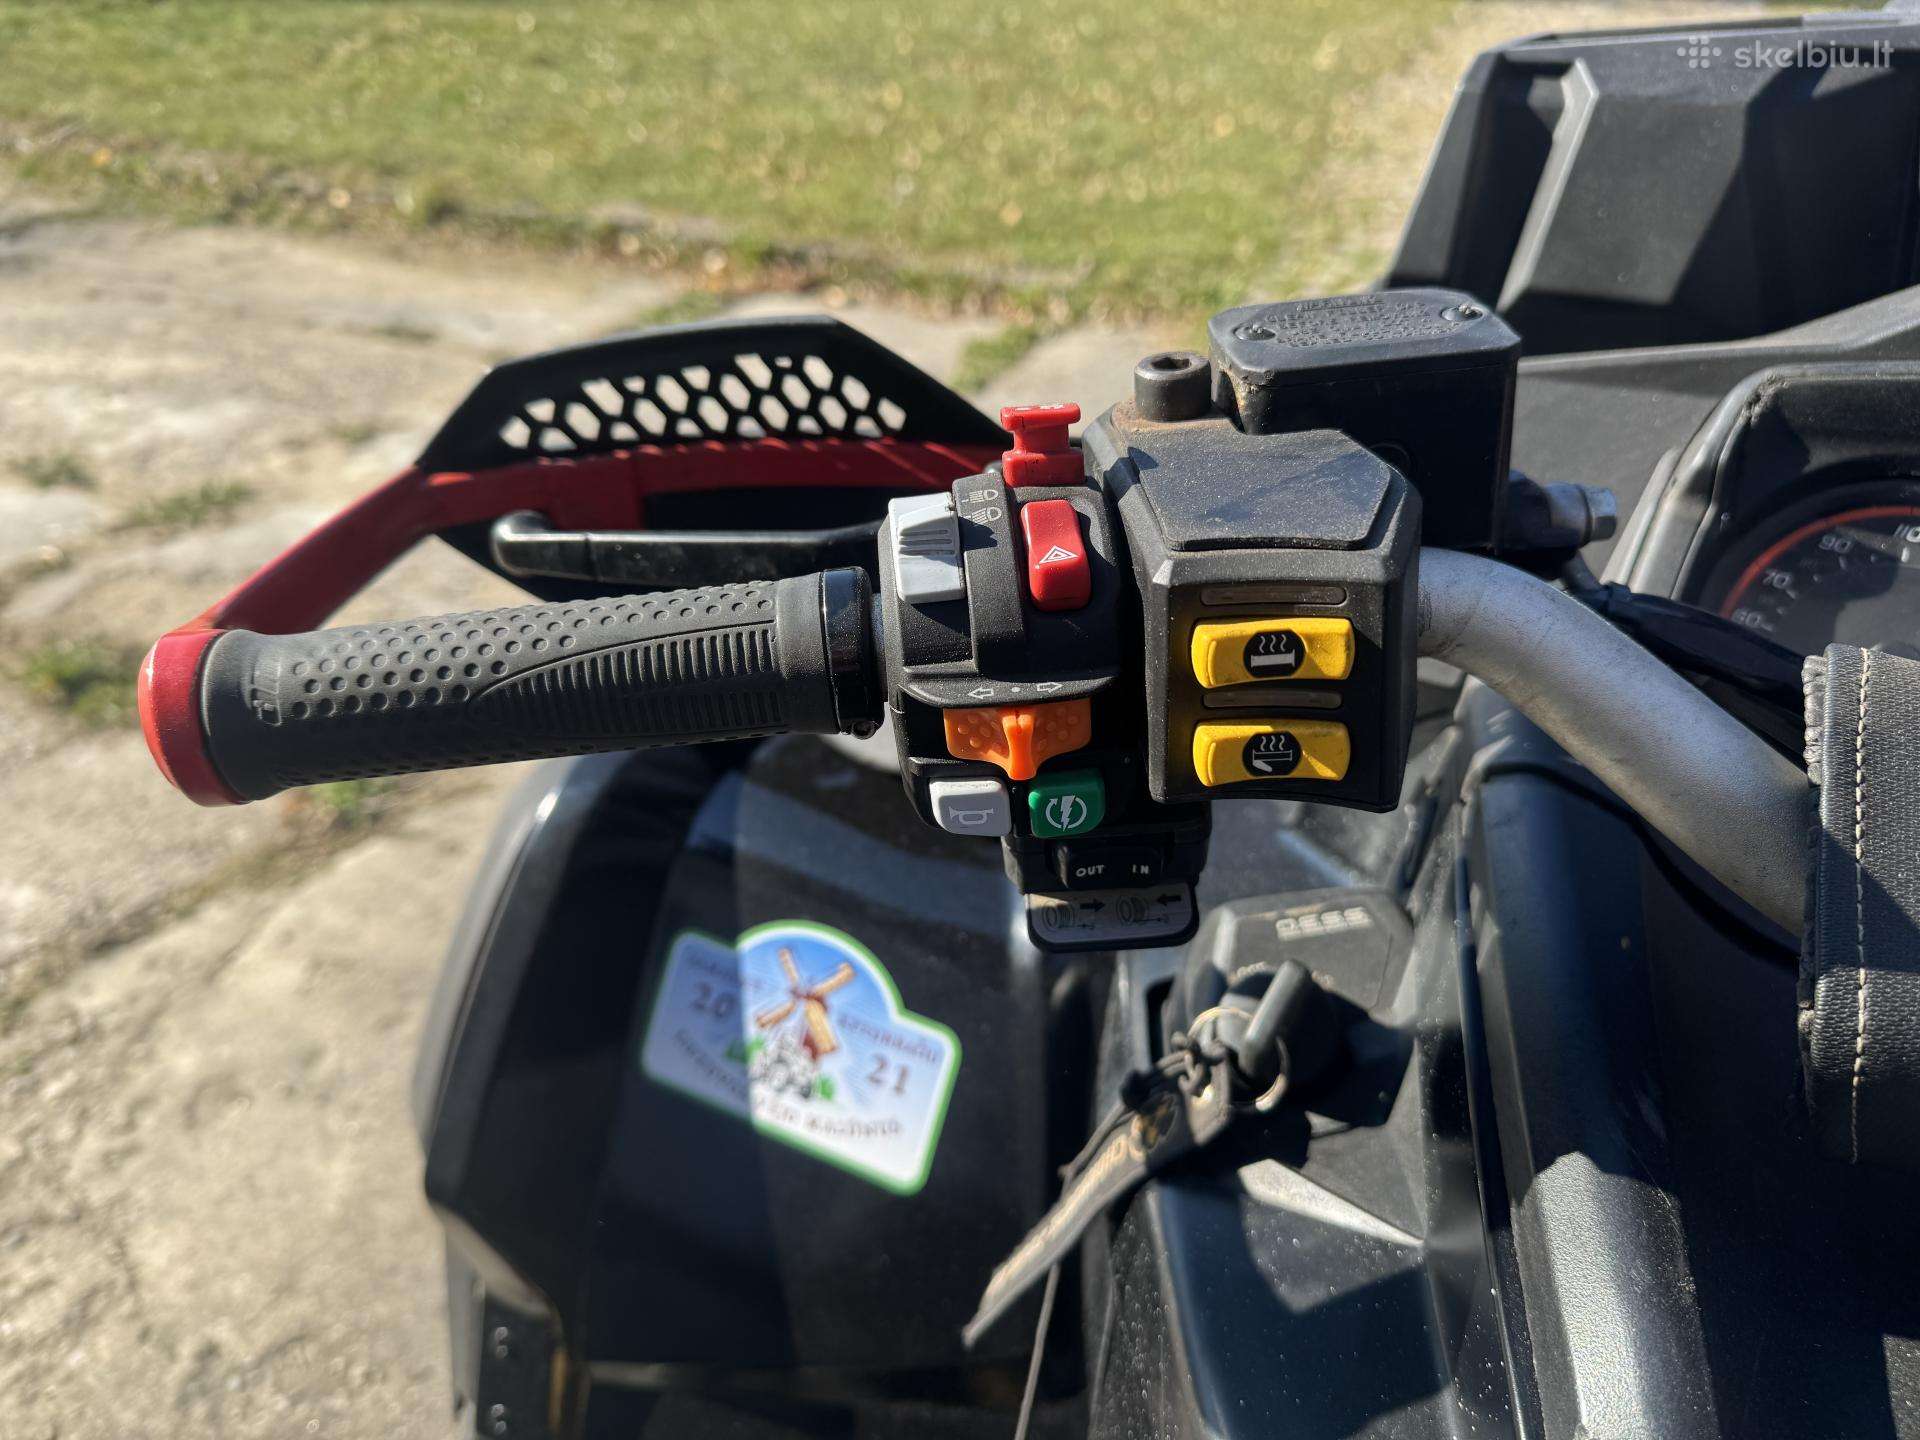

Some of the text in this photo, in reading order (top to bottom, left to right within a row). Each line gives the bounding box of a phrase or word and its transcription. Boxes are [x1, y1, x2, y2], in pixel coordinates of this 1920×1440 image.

[1818, 534, 1852, 554] 90
[1762, 569, 1792, 589] 70
[1075, 864, 1150, 877] OUT IN
[867, 1054, 910, 1095] 21
